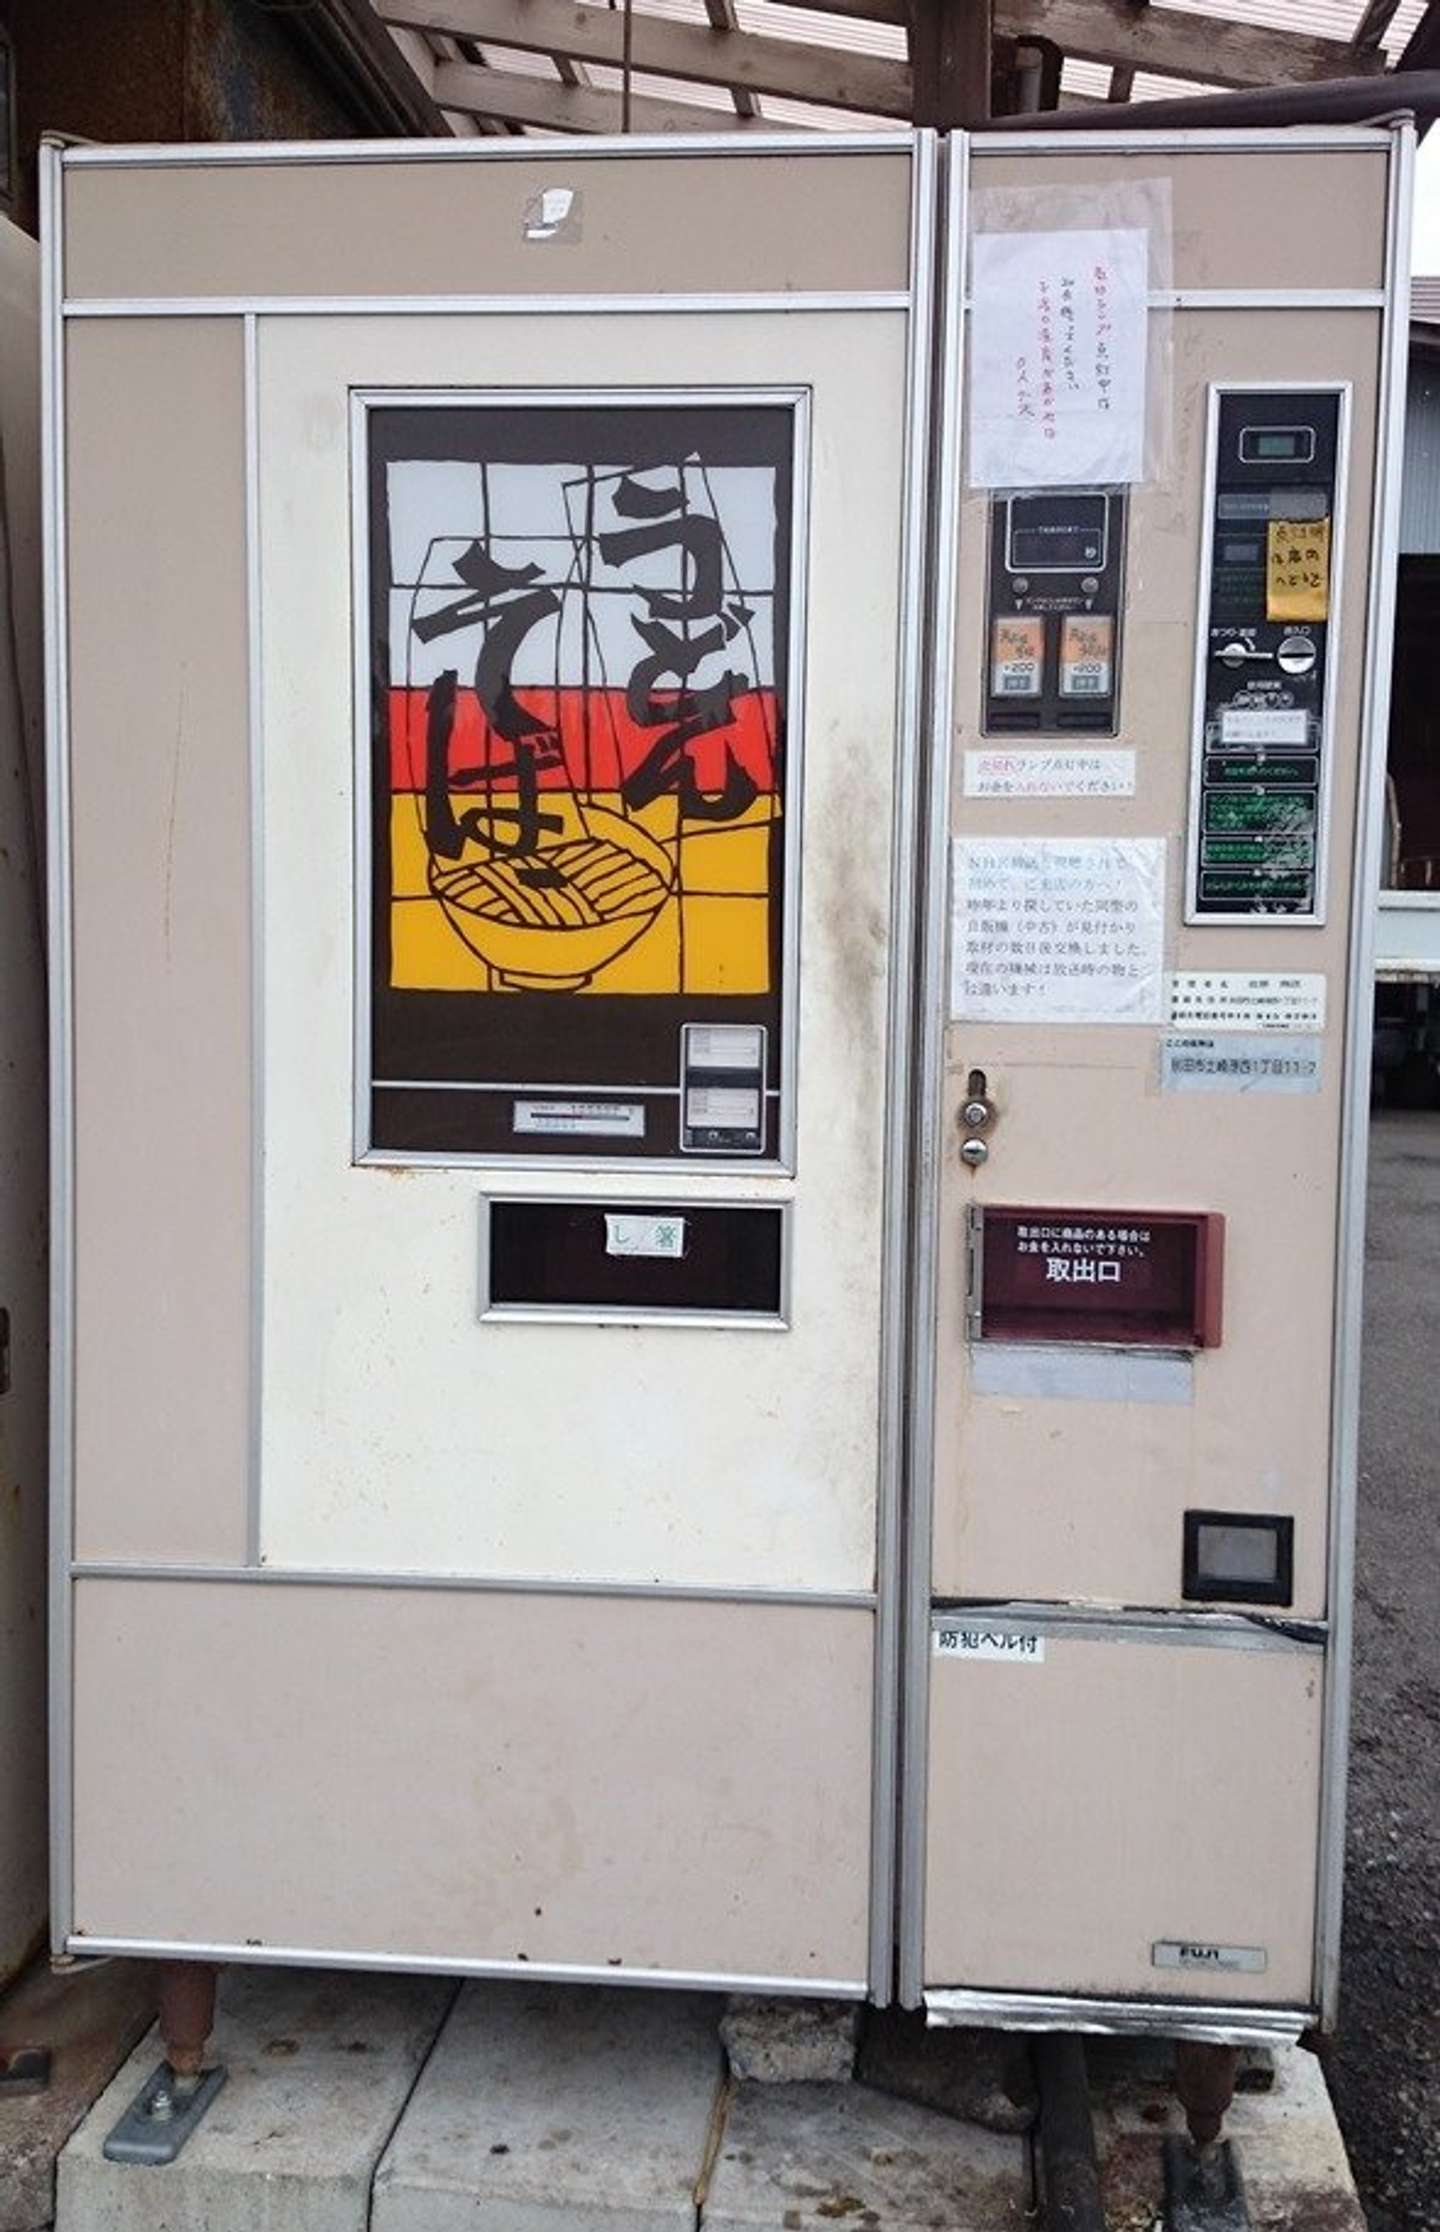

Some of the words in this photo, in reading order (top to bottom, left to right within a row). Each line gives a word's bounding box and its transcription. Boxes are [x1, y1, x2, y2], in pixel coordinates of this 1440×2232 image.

[411, 540, 564, 860] そば
[599, 475, 762, 821] うどん
[1046, 1257, 1120, 1282] 取出口
